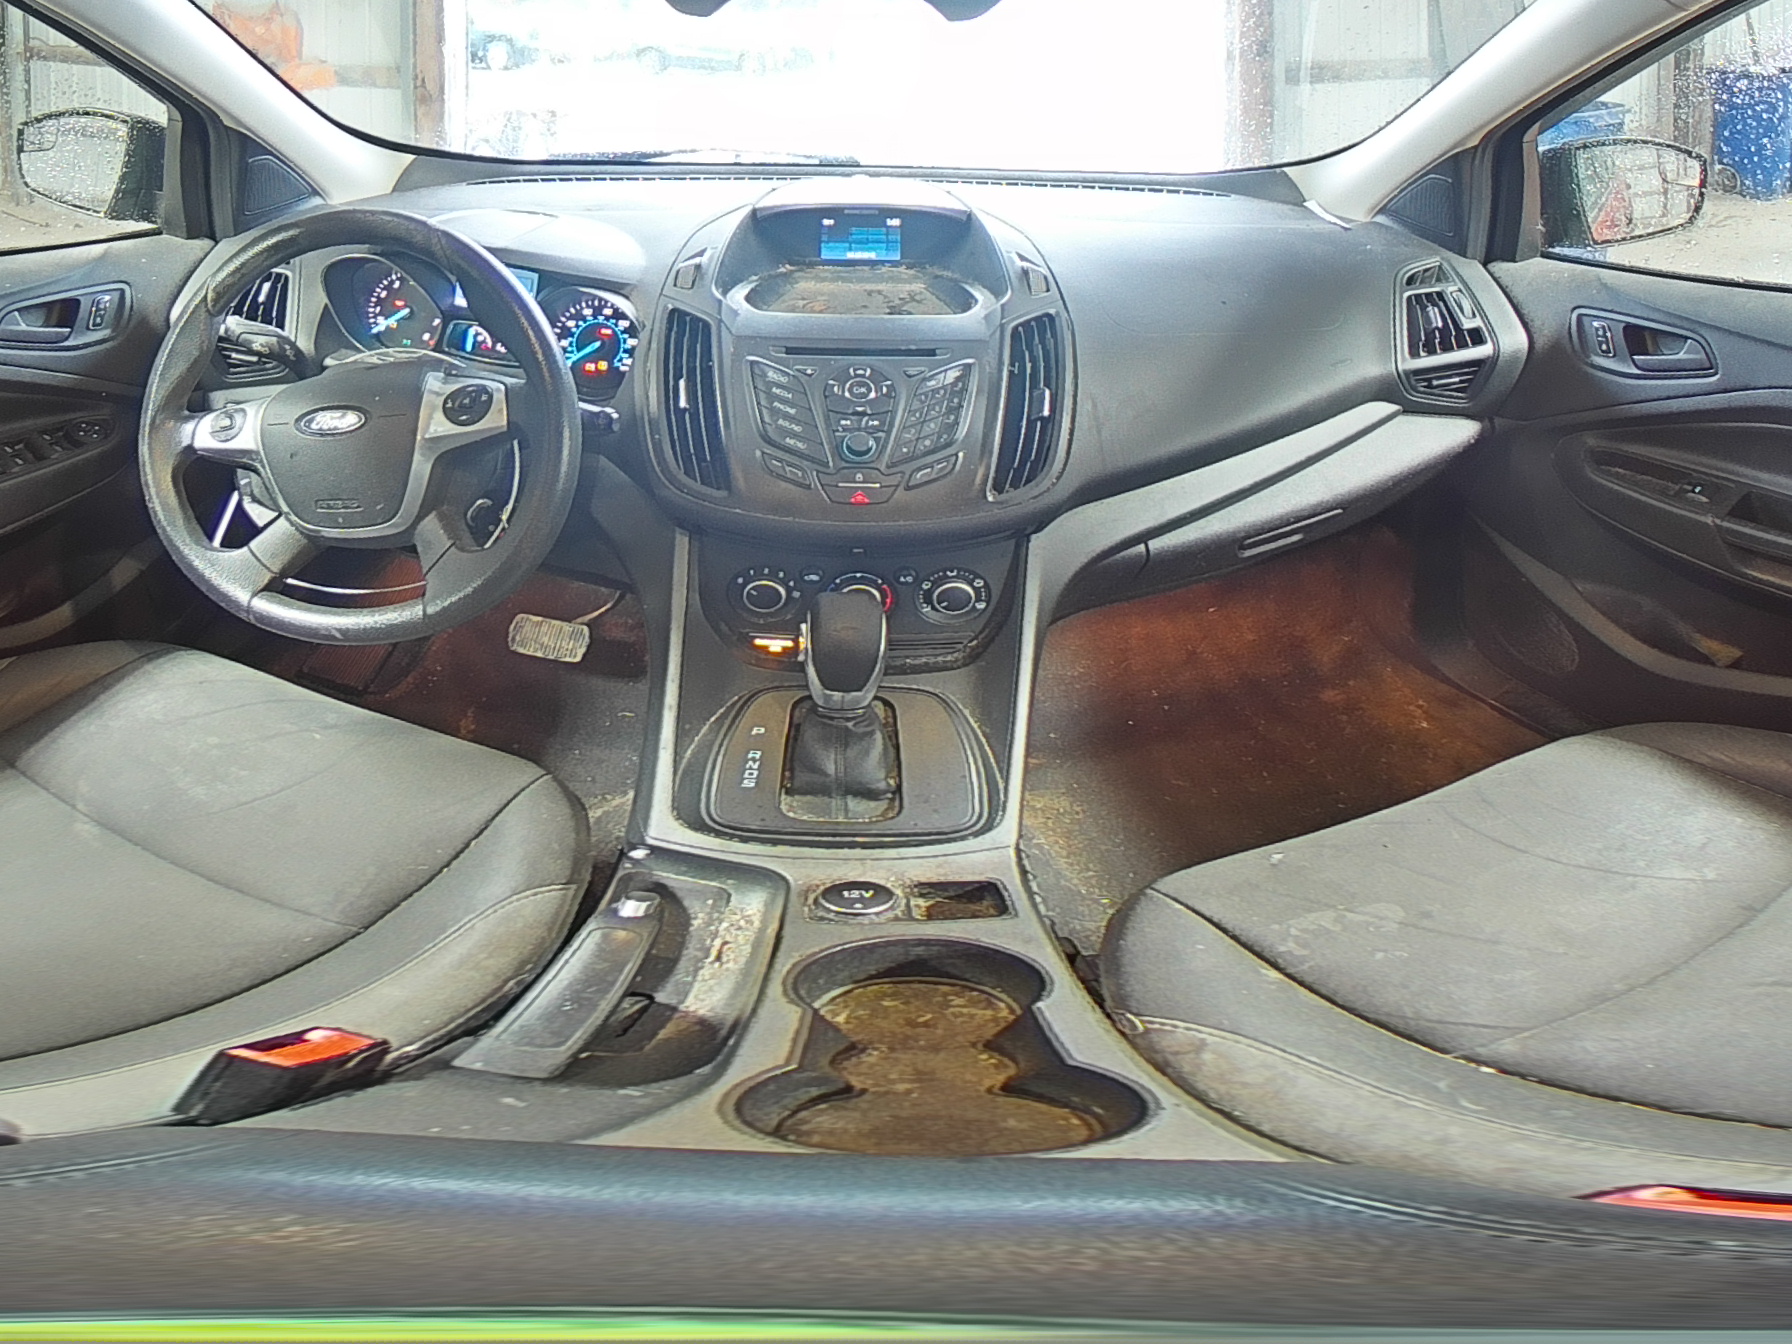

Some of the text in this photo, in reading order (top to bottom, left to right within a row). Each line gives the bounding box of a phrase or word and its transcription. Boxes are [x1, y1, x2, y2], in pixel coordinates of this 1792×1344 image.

[766, 370, 789, 383] RADIO
[771, 386, 793, 399] MEDIA
[853, 386, 868, 394] OK
[772, 401, 798, 414] PHONE
[309, 409, 360, 430] Ford
[777, 418, 803, 433] SOUND
[784, 436, 808, 450] MENU
[750, 726, 766, 735] P
[747, 750, 762, 759] R
[745, 760, 761, 769] N
[743, 769, 759, 778] D
[740, 778, 757, 787] S
[841, 889, 875, 898] 12V
